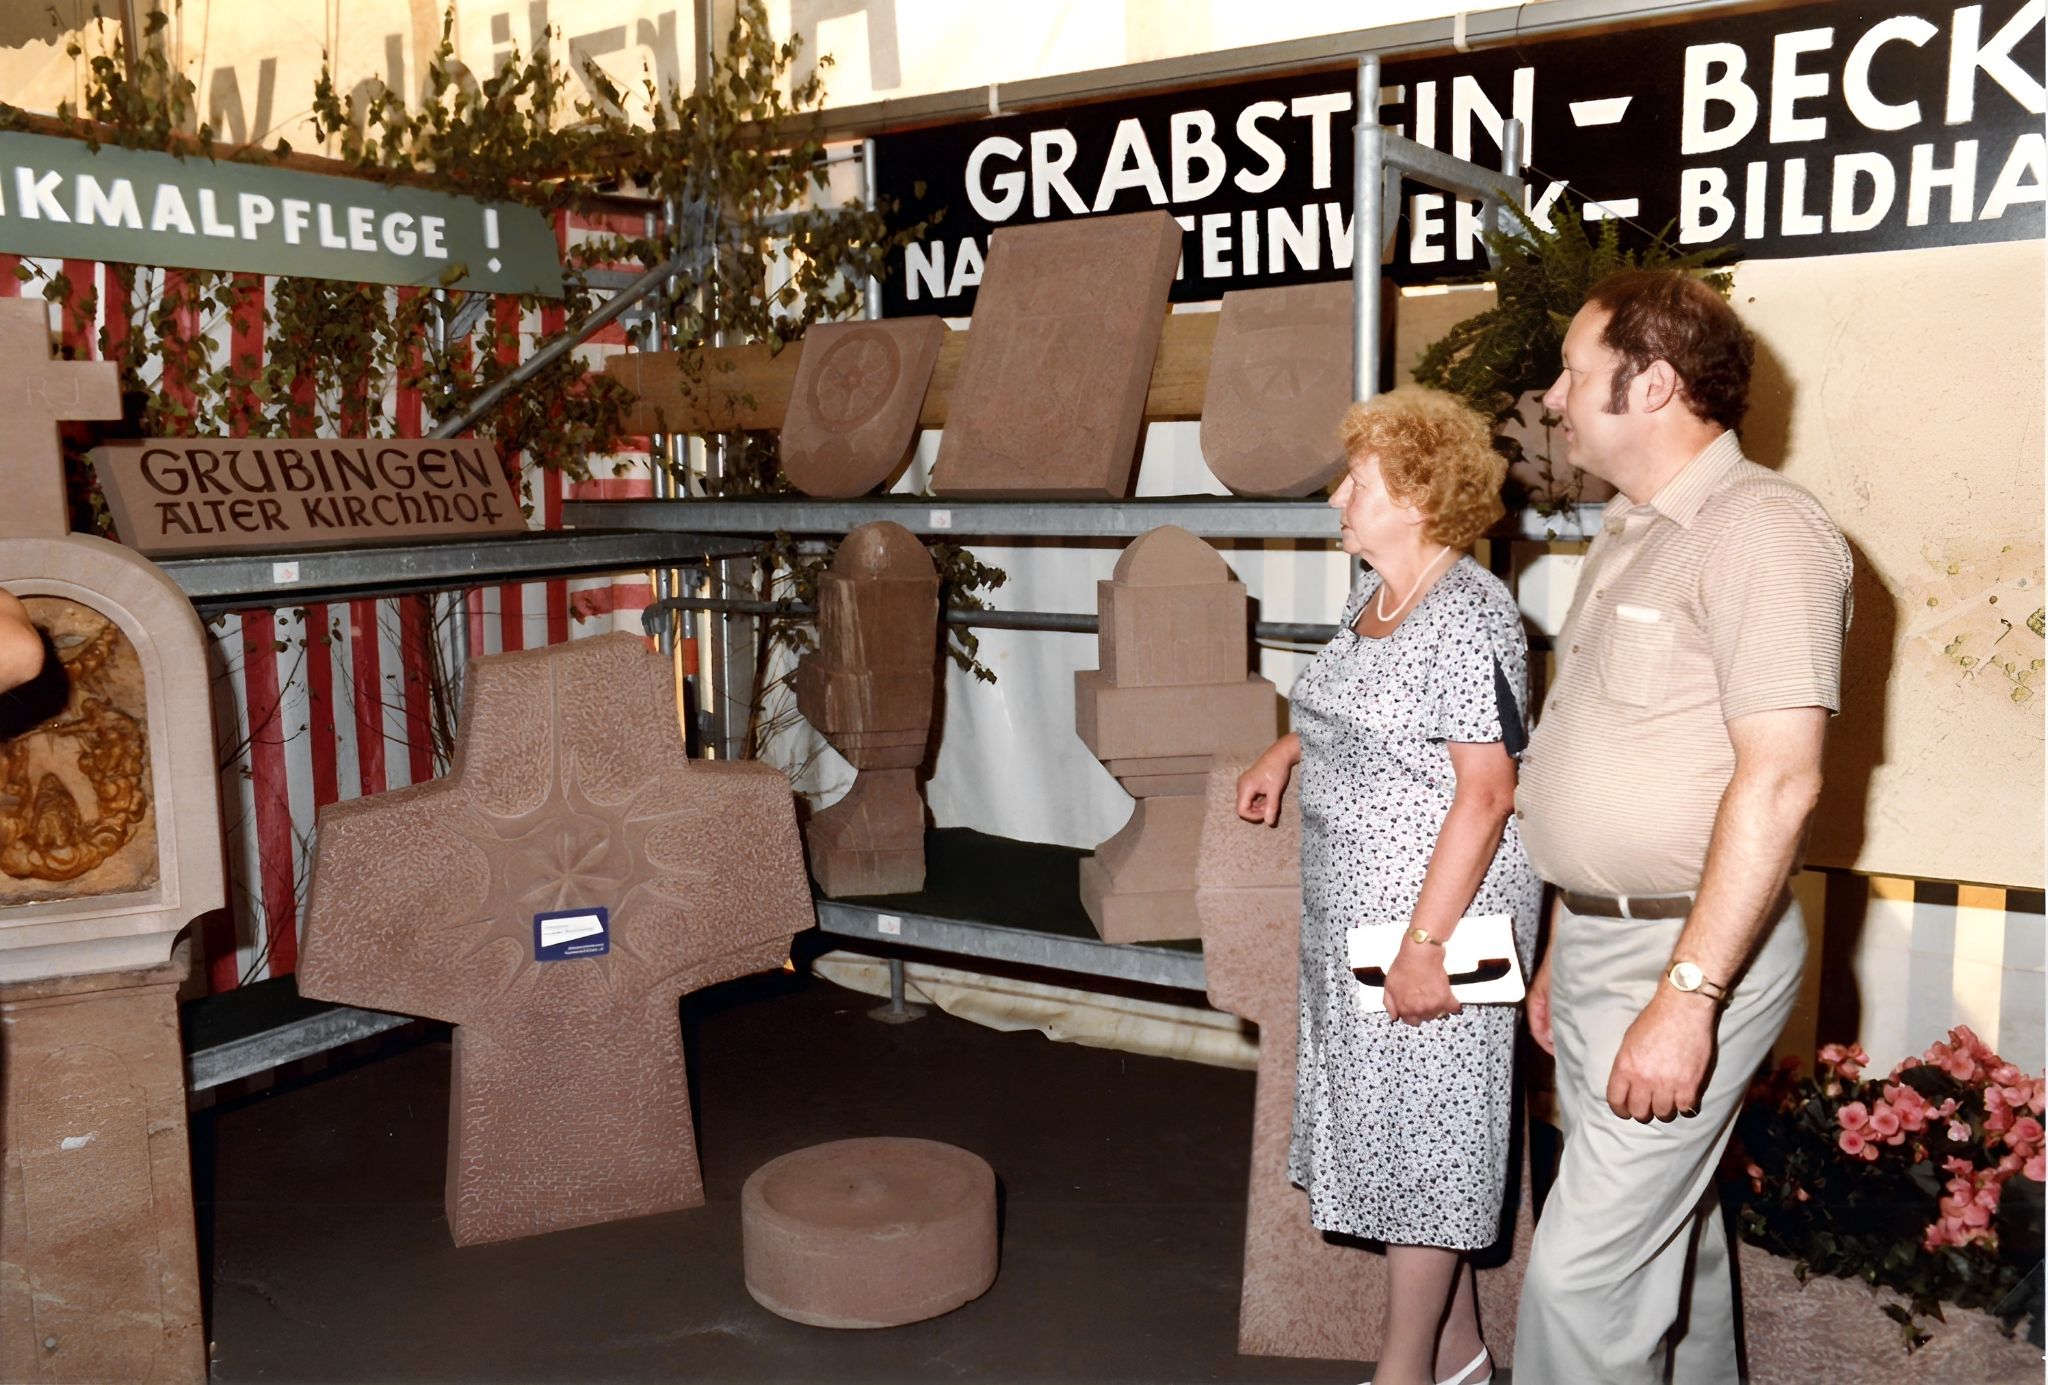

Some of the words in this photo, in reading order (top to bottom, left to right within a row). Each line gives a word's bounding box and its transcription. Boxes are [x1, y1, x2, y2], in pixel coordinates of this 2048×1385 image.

[1681, 0, 2046, 155] BECK
[0, 166, 449, 260] KMALPFLEGE
[140, 448, 493, 496] GRUBINGEN
[154, 498, 291, 536] ALTER
